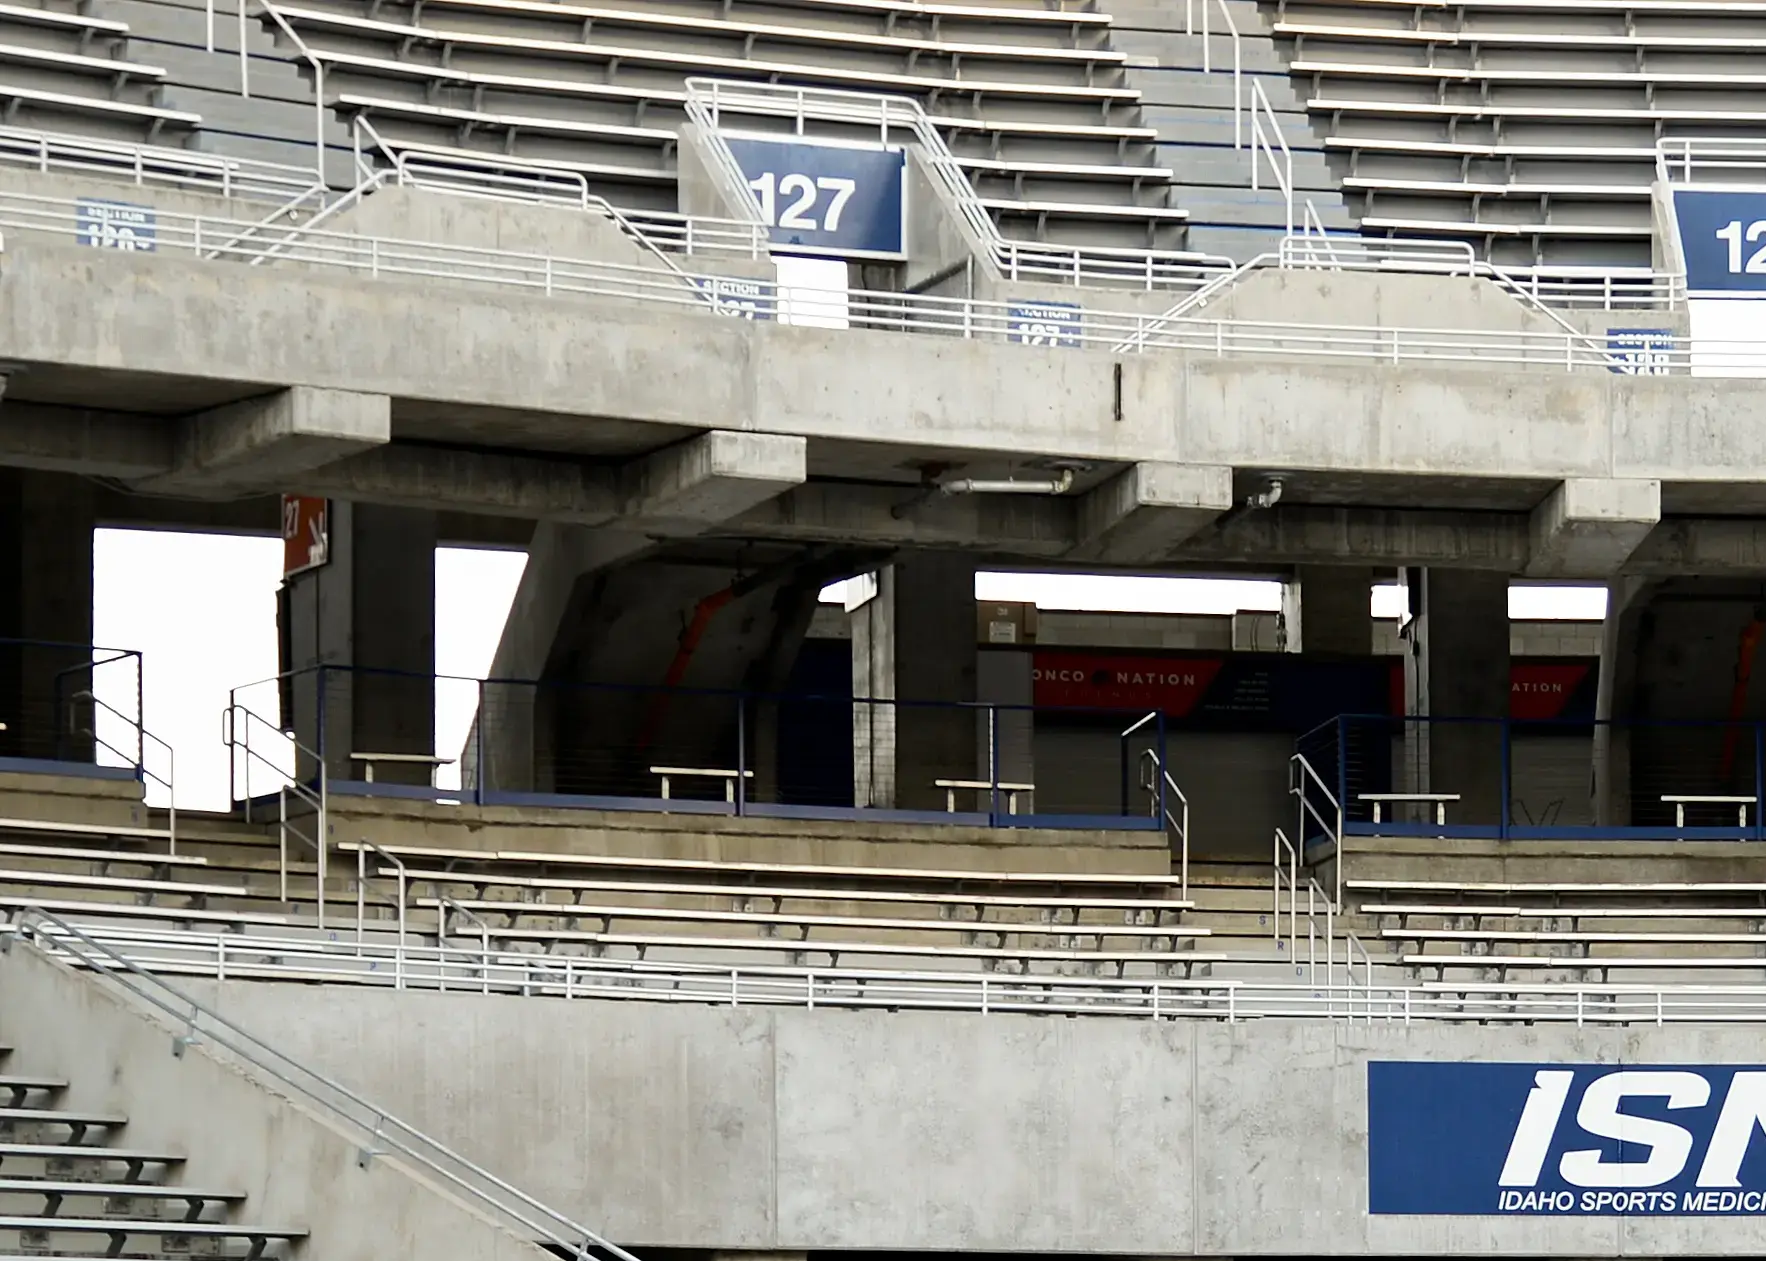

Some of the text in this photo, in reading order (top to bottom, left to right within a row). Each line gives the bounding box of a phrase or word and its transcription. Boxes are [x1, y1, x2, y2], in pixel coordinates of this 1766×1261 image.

[748, 171, 856, 233] 127
[703, 280, 759, 295] SCTION
[1018, 323, 1060, 347] 127
[1032, 668, 1196, 687] ONCO NATION
[1511, 682, 1563, 693] ATION
[1498, 1190, 1575, 1212] IDAHO
[1579, 1190, 1678, 1213] SPORTS
